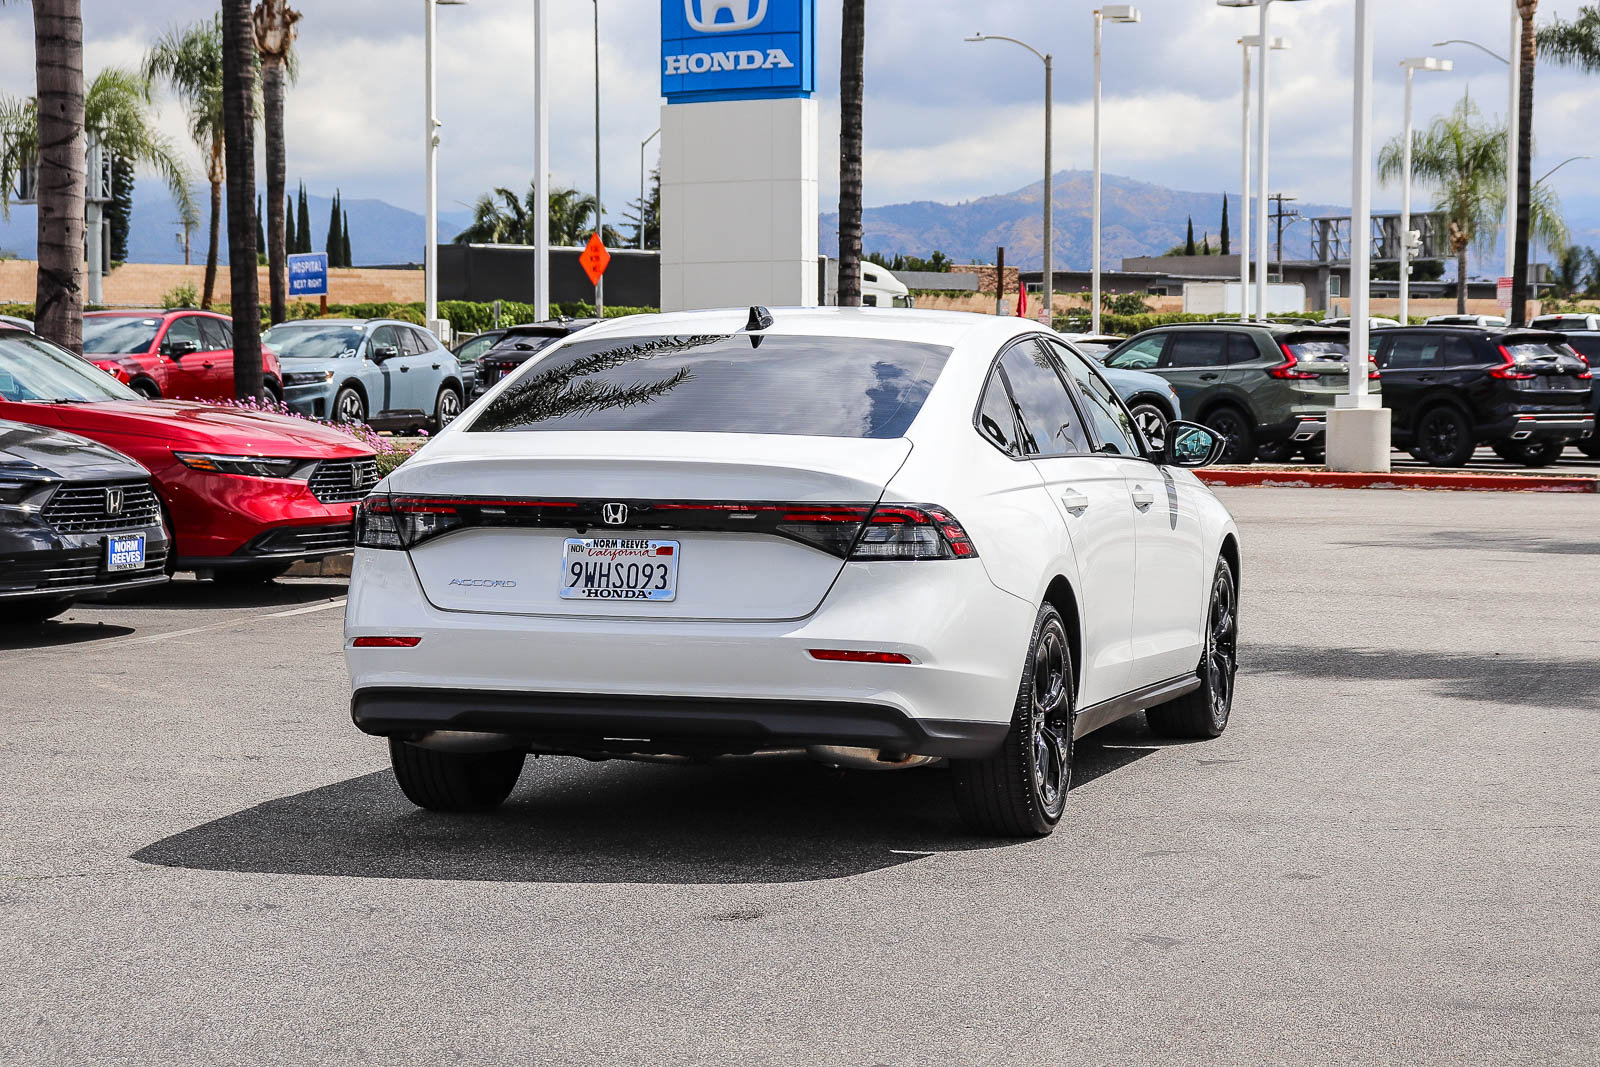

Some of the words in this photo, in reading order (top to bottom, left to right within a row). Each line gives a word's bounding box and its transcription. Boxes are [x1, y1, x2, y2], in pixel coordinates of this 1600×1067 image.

[664, 48, 795, 76] HONDA
[292, 260, 323, 273] HOSPITAL
[293, 279, 307, 289] NEXT
[114, 540, 138, 553] NORM
[570, 545, 585, 553] NOV
[593, 540, 618, 548] NORM
[621, 539, 649, 549] REEVES
[111, 551, 141, 564] REEVES
[588, 548, 656, 561] California
[569, 561, 668, 590] 9WHS093
[448, 578, 517, 588] ACCORD
[586, 589, 649, 599] HONDA
